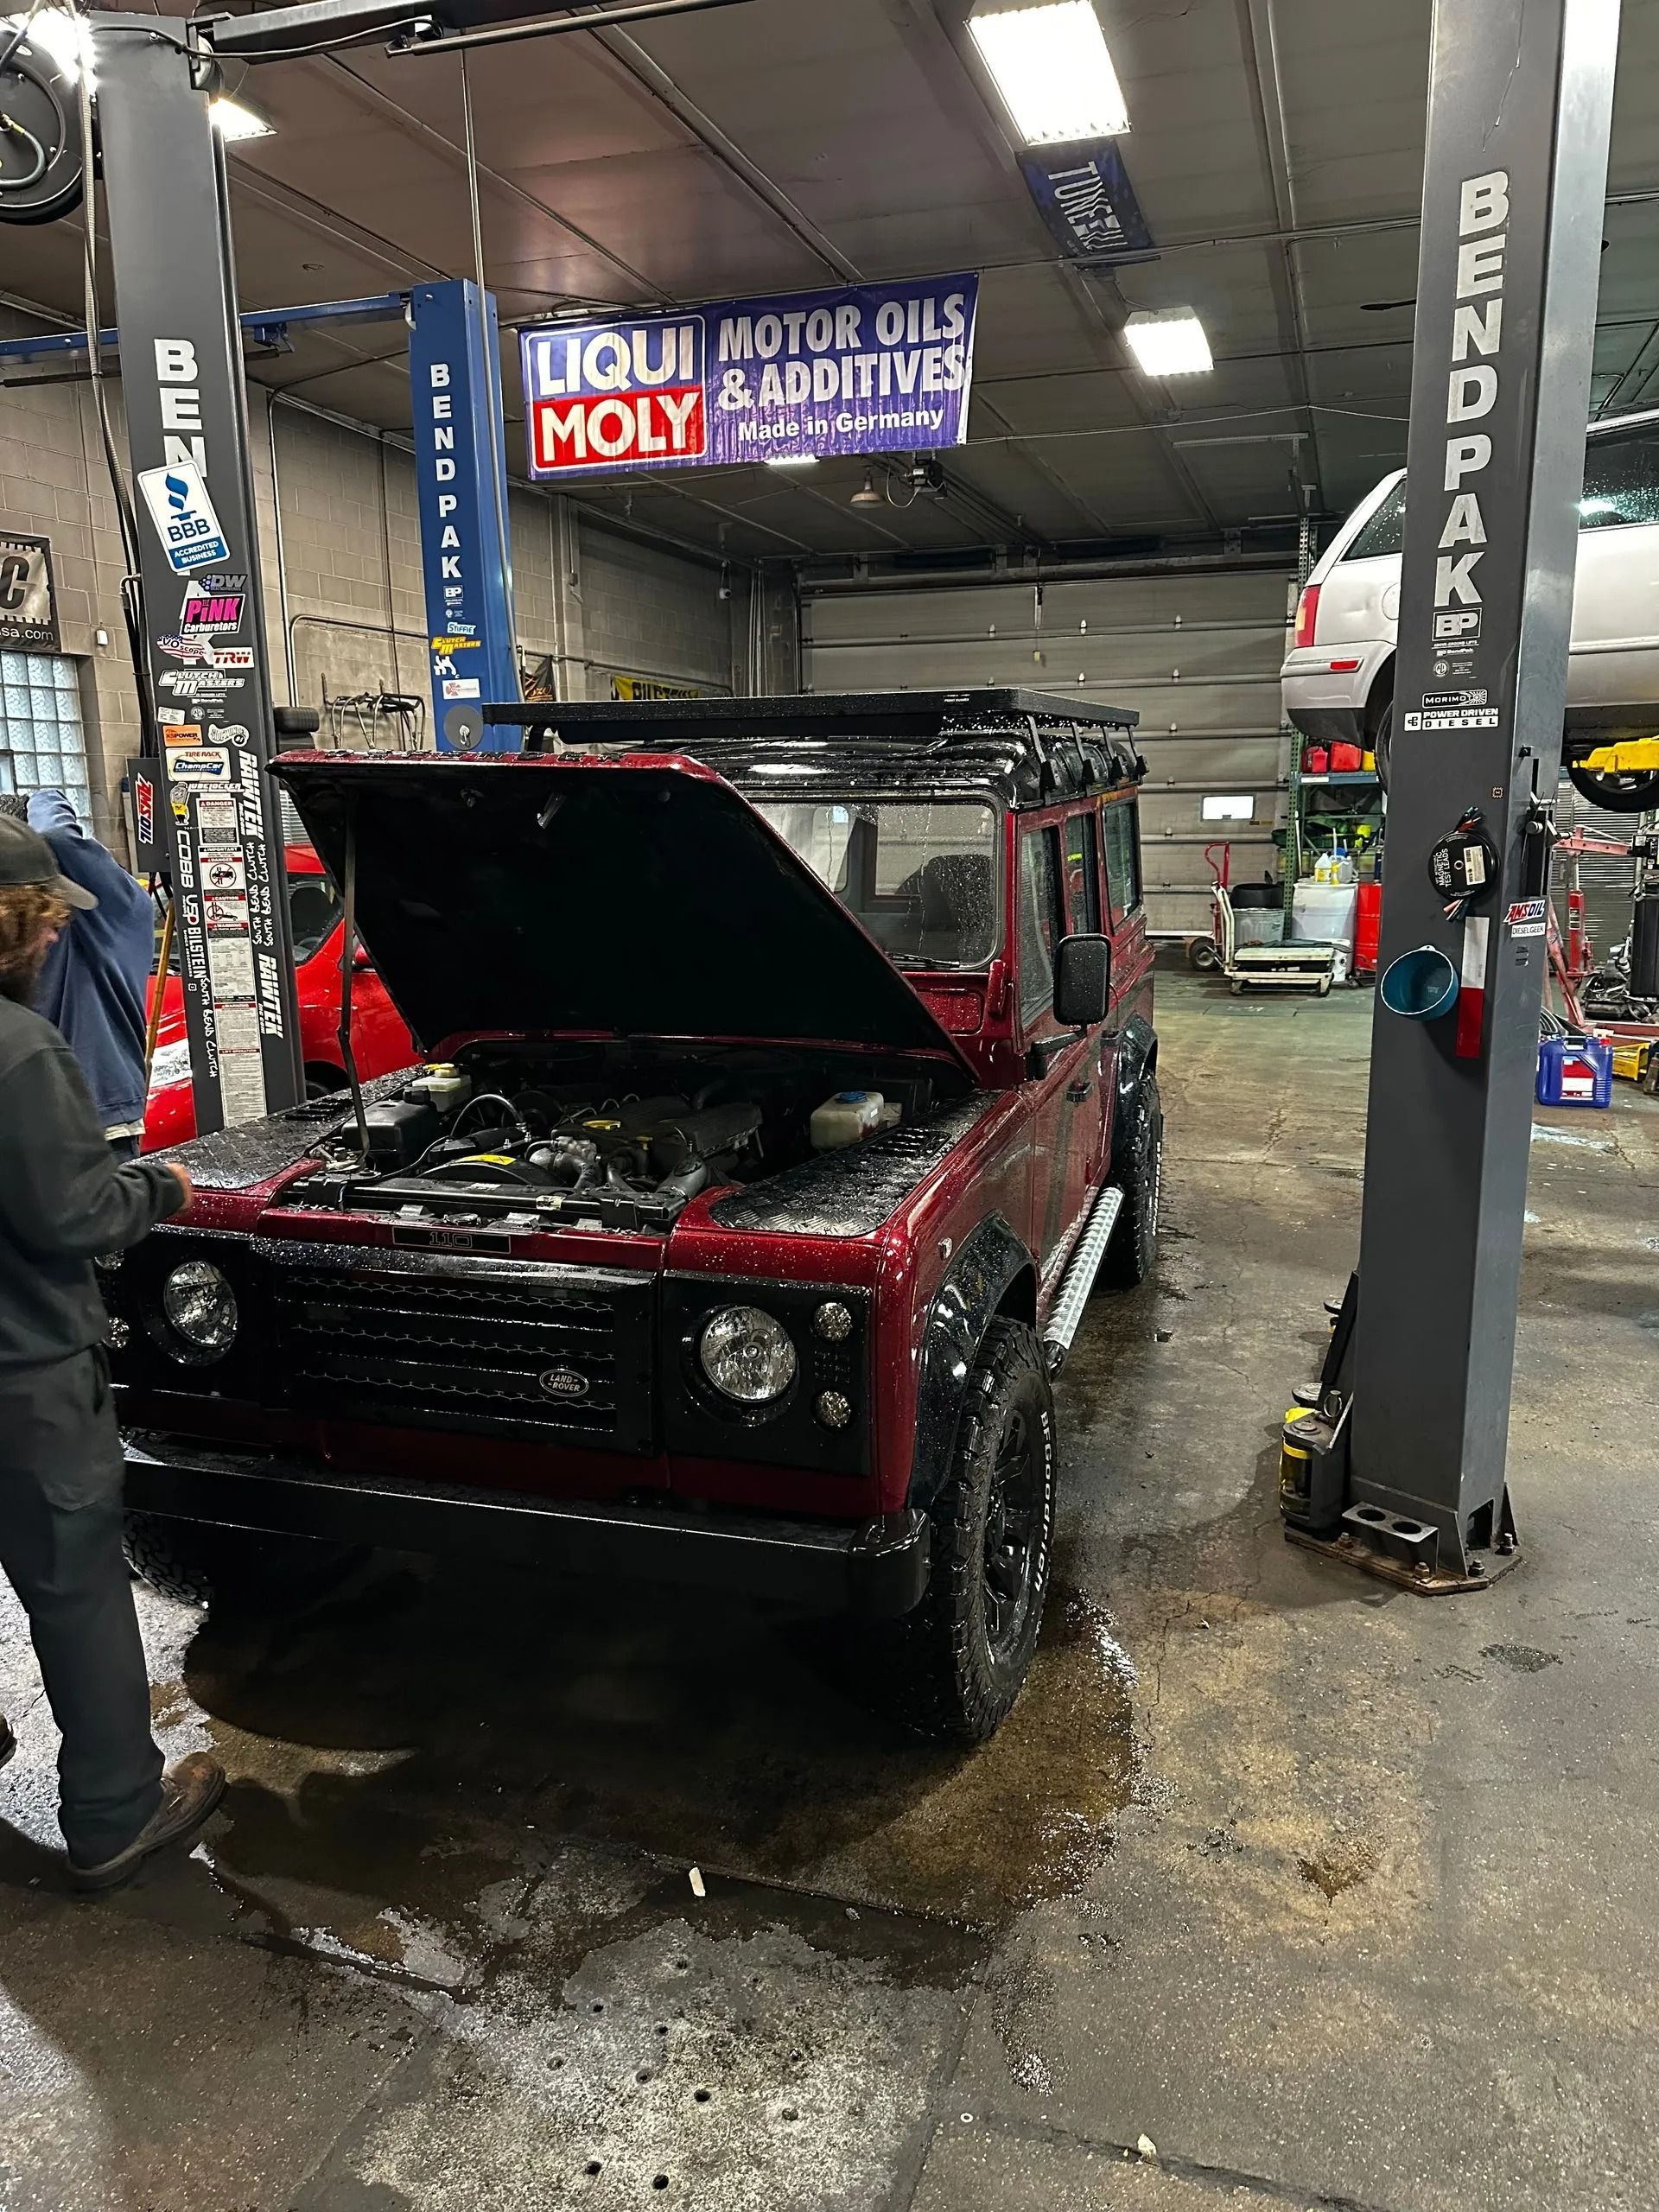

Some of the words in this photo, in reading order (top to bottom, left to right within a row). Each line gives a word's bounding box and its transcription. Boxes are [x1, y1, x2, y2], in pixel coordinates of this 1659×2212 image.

[718, 304, 863, 362] MOTOR
[875, 293, 965, 346] OILS
[537, 326, 694, 396] LIQUI
[719, 368, 754, 410] &
[758, 343, 966, 408] ADDITIVES
[1433, 170, 1510, 607] BENDPAK
[540, 391, 699, 462] MOLY
[738, 419, 800, 442] Made
[807, 416, 827, 435] in
[836, 409, 944, 437] Germany
[430, 363, 462, 579] BENDPAK
[168, 518, 210, 542] BBB
[175, 541, 219, 558] ACCREDITED
[181, 550, 216, 563] BUSINESS
[210, 575, 247, 588] DW
[445, 587, 462, 597] BP
[0, 626, 54, 641] sa.com
[184, 622, 238, 633] Carburetors
[1435, 612, 1478, 637] BP
[433, 637, 466, 649] CLUTCH
[440, 640, 480, 654] MASTERS
[213, 652, 251, 664] TRW
[160, 671, 219, 685] CLUTCH
[173, 678, 245, 695] MASTERS
[1423, 709, 1459, 719] POWER
[1460, 708, 1499, 717] DRIVEN
[1425, 718, 1496, 728] DIESEL
[175, 761, 223, 770] ChampCar
[137, 773, 153, 843] AMSOIL
[238, 750, 264, 841] RAWTEK
[177, 830, 194, 888] COBB
[245, 842, 257, 880] CLUTCH
[257, 843, 269, 882] CLUTCH
[1435, 851, 1446, 887] MAGNETIC
[1441, 848, 1451, 870] LEADS
[1444, 871, 1452, 887] TEST
[249, 884, 259, 913] BEND
[260, 886, 271, 915] BEND
[1507, 902, 1544, 923] AMSOIL
[251, 917, 262, 944] SOUTH
[264, 918, 274, 947] SOUTH
[188, 927, 207, 979] BILSTEIN
[200, 977, 211, 1006] SOUTH
[258, 953, 284, 1039] RAWTEK
[203, 1009, 214, 1037] BEND
[206, 1039, 219, 1078] CLUTCH
[429, 1232, 473, 1249] 110
[550, 1374, 573, 1383] LAND
[552, 1382, 581, 1392] ROVER
[1034, 1410, 1052, 1592] BFGoodrich
